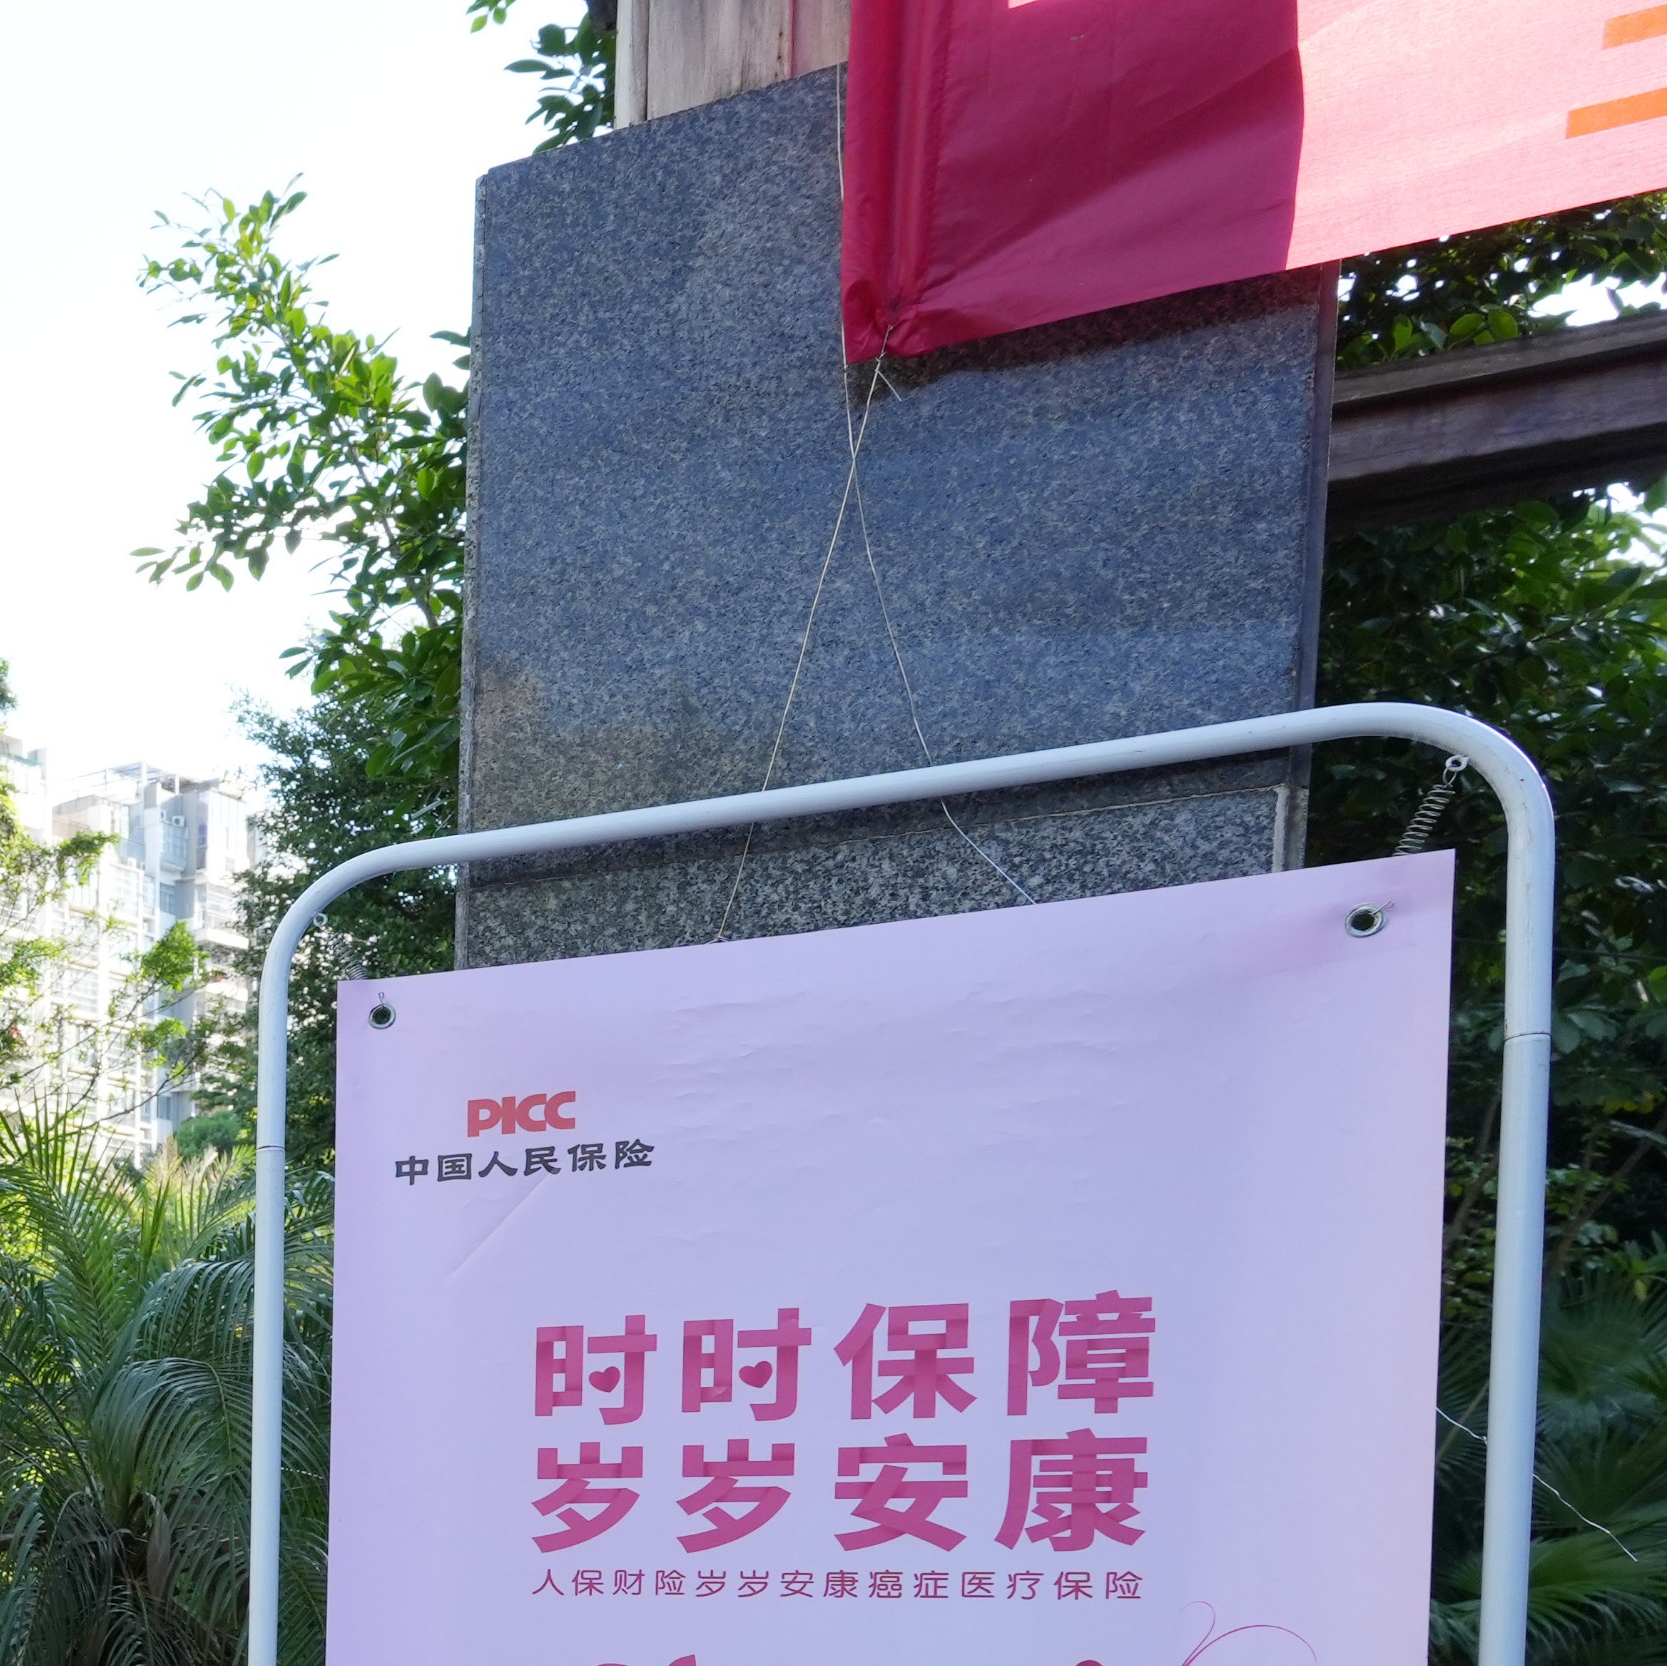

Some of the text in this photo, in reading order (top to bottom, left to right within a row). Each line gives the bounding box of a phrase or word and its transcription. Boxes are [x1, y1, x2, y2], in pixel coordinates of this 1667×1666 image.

[467, 1090, 576, 1138] PICC
[393, 1138, 655, 1186] 中国人民保险
[533, 1289, 1156, 1427] 时时保障
[530, 1427, 1150, 1554] 岁岁安康
[531, 1566, 1143, 1600] 人保财险岁岁安康癌症医疗保险
